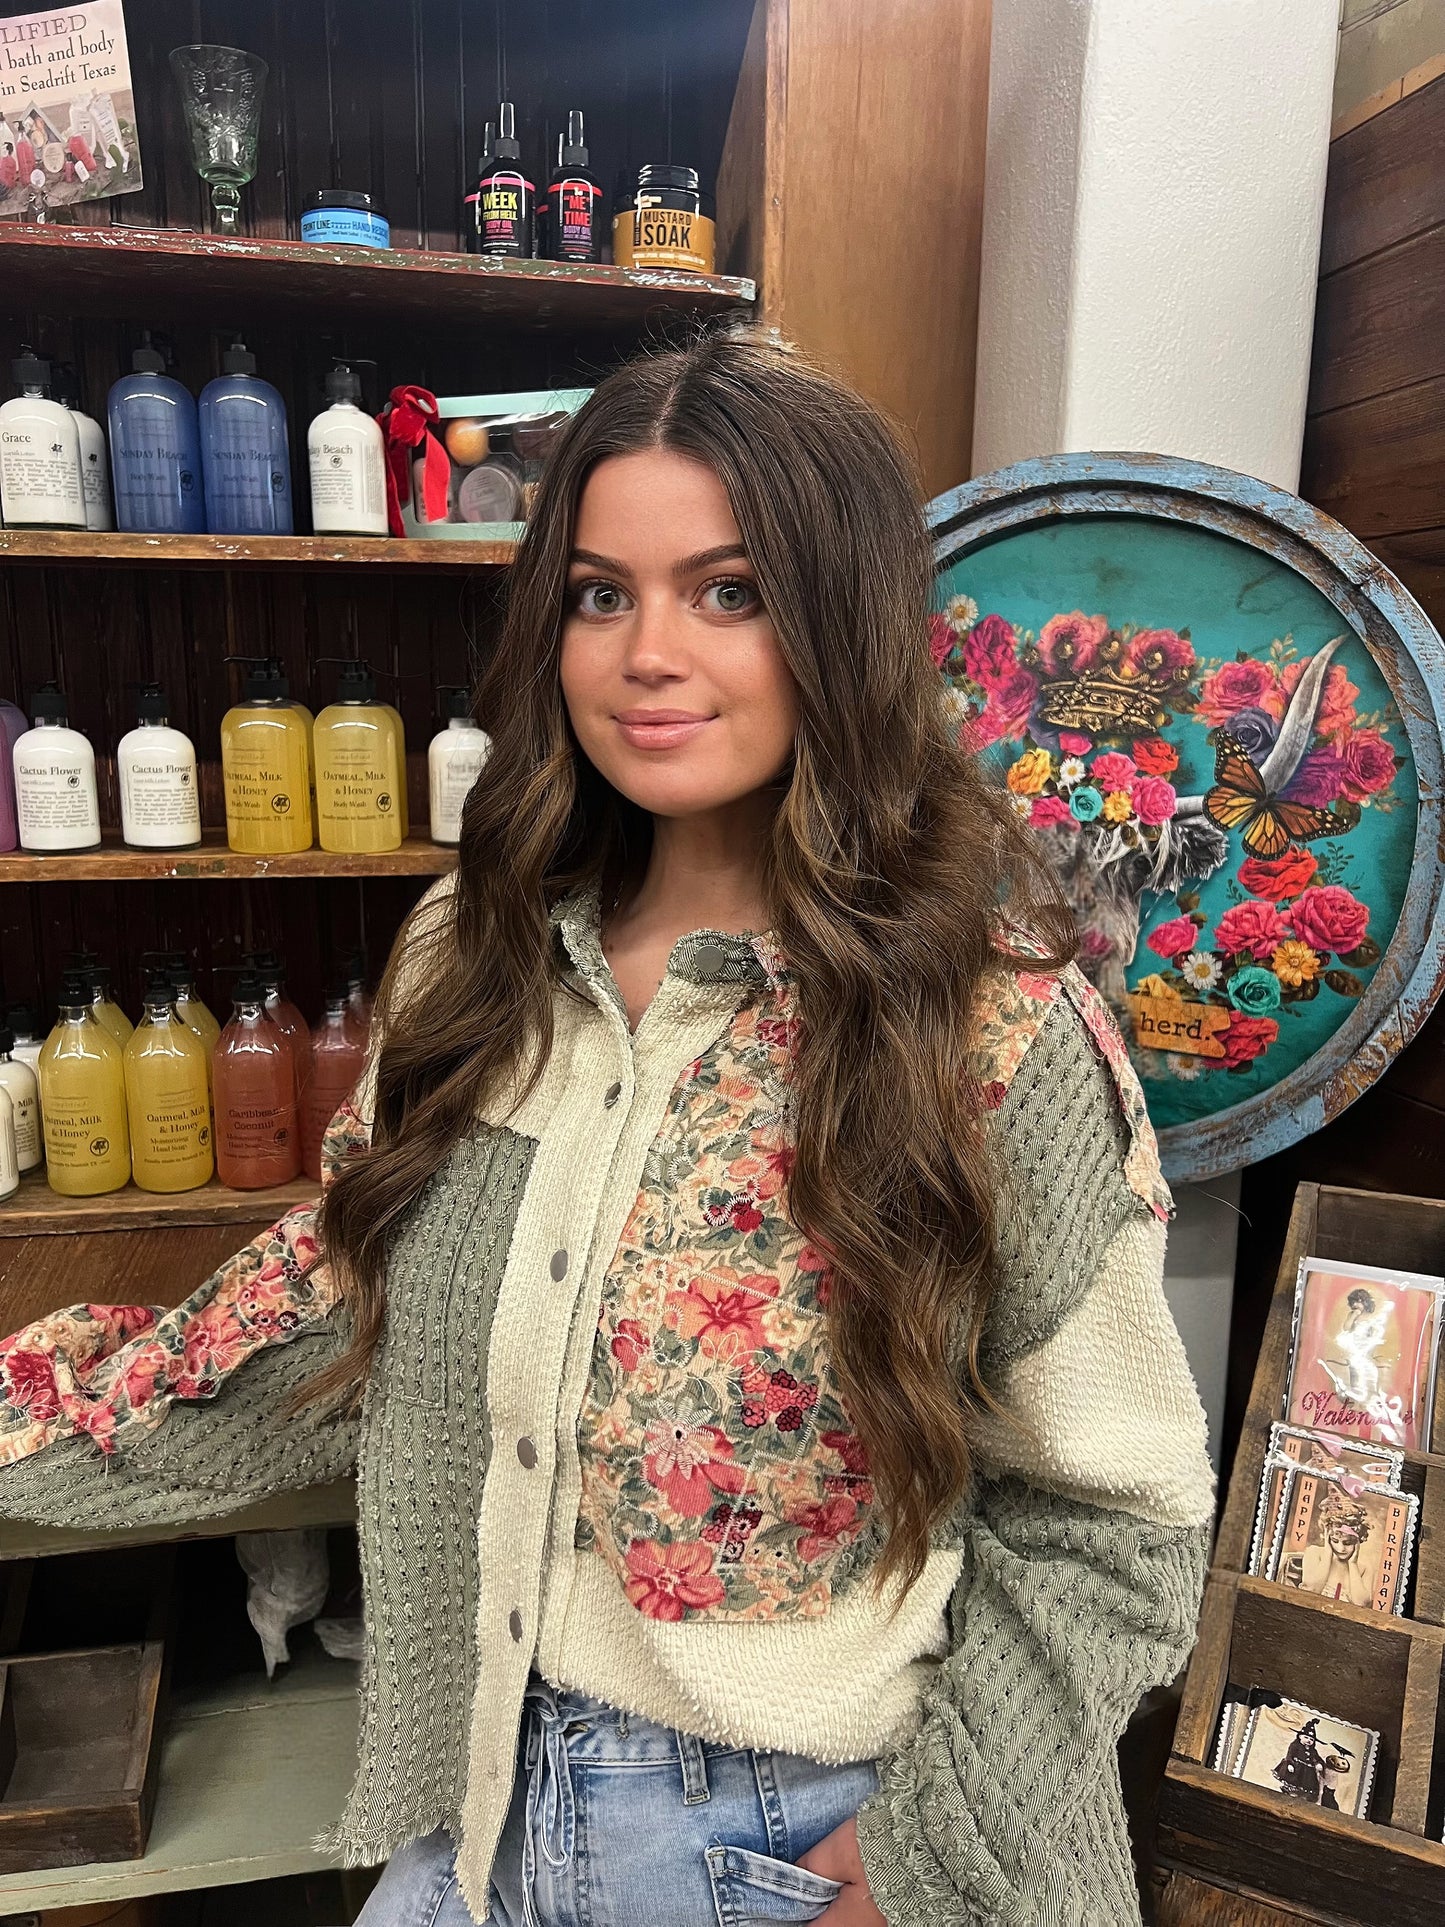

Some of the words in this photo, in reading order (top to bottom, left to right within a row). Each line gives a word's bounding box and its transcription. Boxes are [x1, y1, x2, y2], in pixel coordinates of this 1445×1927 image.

[5, 44, 42, 69] bath
[47, 37, 75, 62] and
[79, 29, 115, 55] body
[1, 82, 16, 95] in
[20, 64, 76, 92] Seadrift
[79, 63, 116, 80] Texas
[482, 191, 518, 210] WEEK
[564, 211, 591, 227] TIME
[643, 211, 692, 226] MUSTARD
[643, 223, 691, 249] SOAK
[1, 431, 32, 443] Grace
[322, 444, 353, 454] Beach
[19, 765, 48, 775] Cactus
[50, 766, 82, 776] Flower
[132, 764, 163, 774] Cactus
[166, 764, 192, 773] Flower
[1140, 1011, 1211, 1041] herd.
[79, 1115, 102, 1126] Milk
[146, 1110, 188, 1123] Oatmeal,
[59, 1128, 91, 1140] Honey
[170, 1121, 199, 1133] Honey
[1295, 1480, 1313, 1542] HAPPY
[1377, 1507, 1401, 1612] BIRTHDAY
